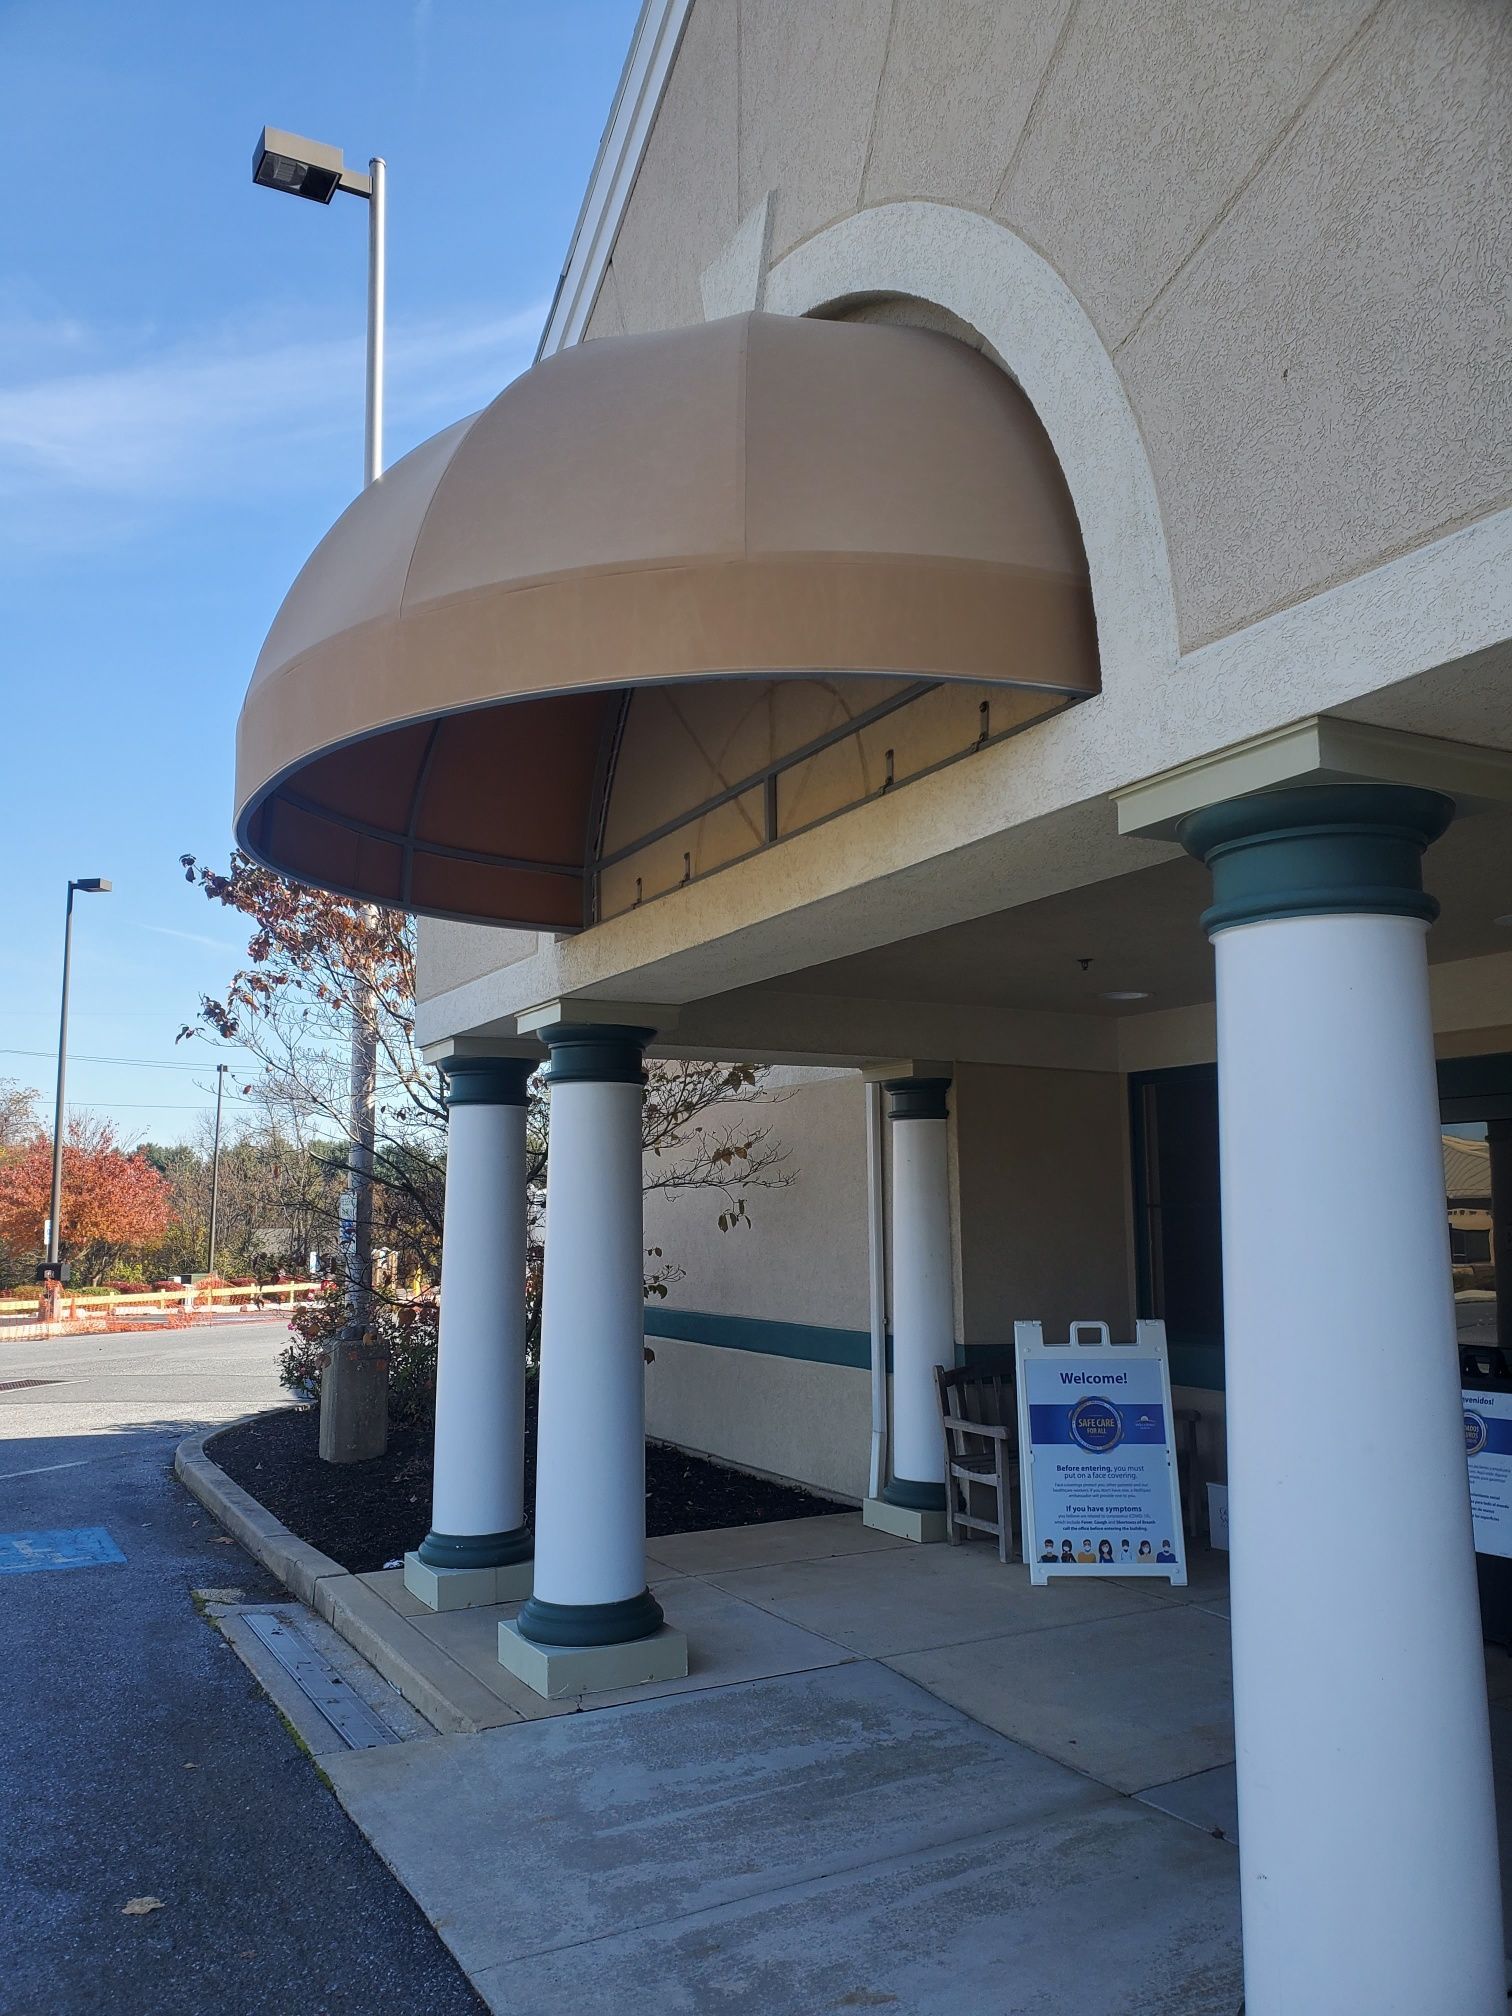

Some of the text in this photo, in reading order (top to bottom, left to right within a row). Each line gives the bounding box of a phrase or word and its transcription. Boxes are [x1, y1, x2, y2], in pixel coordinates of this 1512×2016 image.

[1060, 1372, 1128, 1384] Welcome!
[1078, 1418, 1115, 1427] SAFE CARE
[1081, 1465, 1113, 1473] entering,
[1064, 1472, 1076, 1480] put
[1107, 1472, 1138, 1480] covering.
